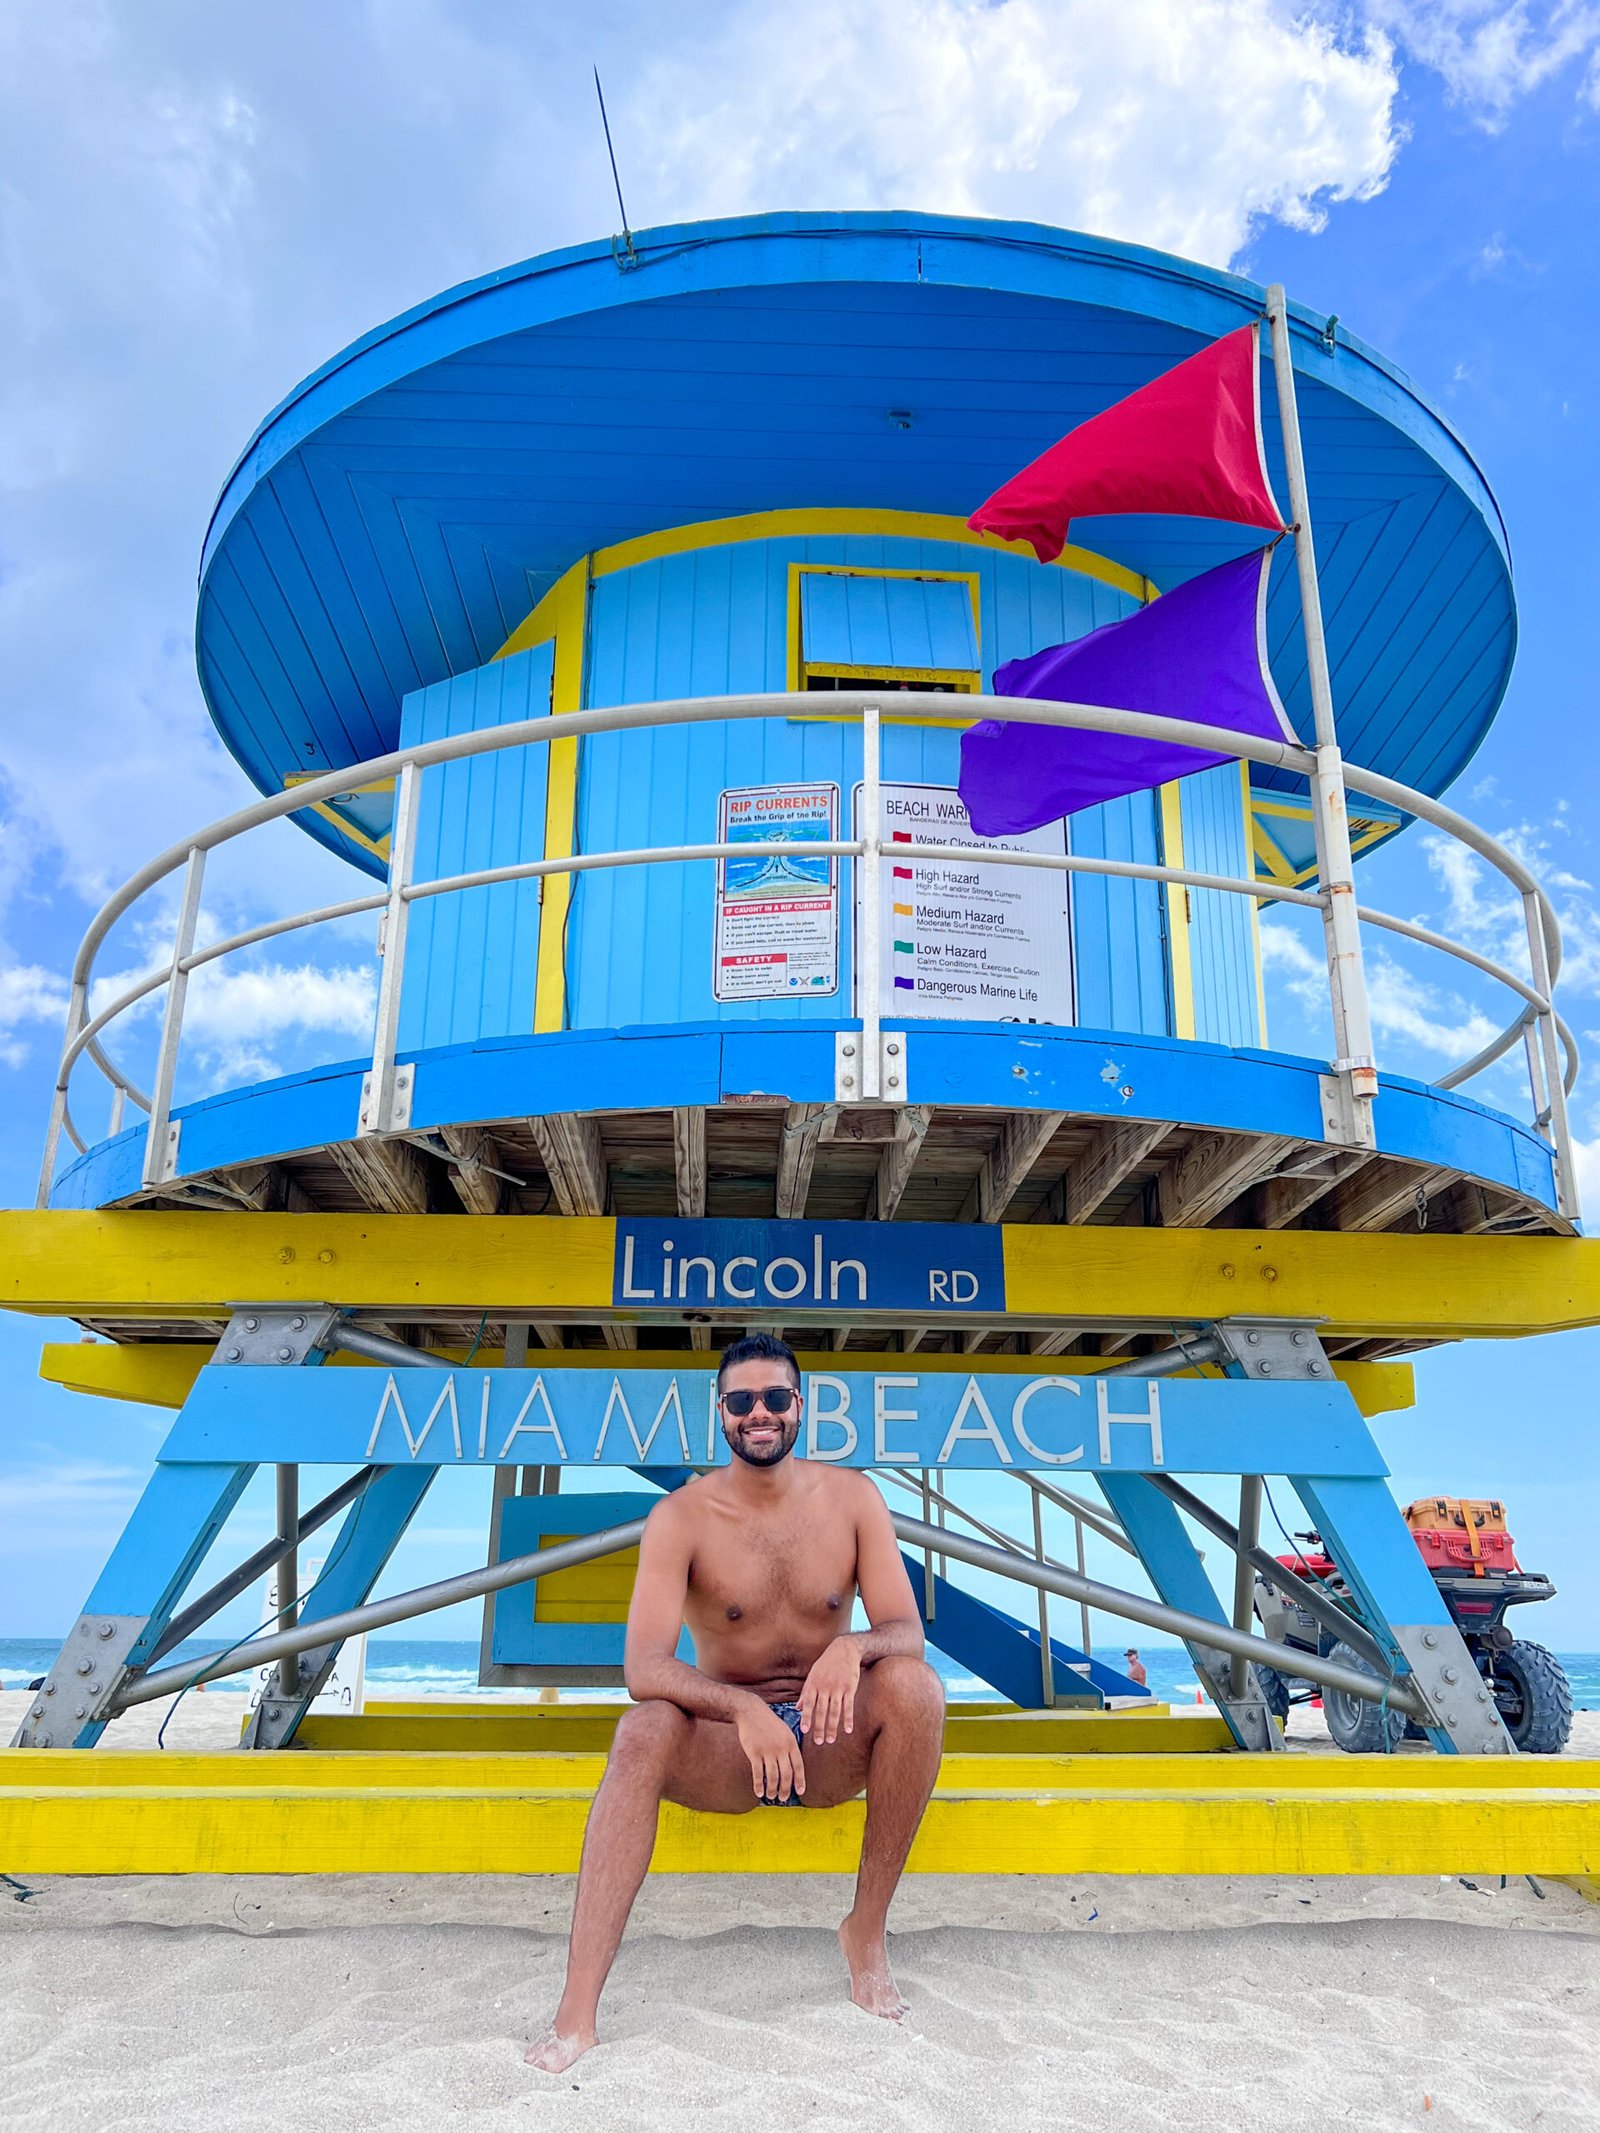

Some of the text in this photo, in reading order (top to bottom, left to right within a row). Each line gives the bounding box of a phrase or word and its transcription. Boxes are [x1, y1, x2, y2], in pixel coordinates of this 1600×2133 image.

[730, 796, 828, 812] RIP CURRENTS
[886, 800, 929, 816] BEACH
[768, 813, 784, 821] Grip
[916, 834, 947, 846] Water
[916, 869, 980, 885] High Hazard
[972, 887, 993, 897] Strong
[994, 890, 1022, 900] Currents
[916, 905, 1004, 925] Medium Hazard
[916, 918, 951, 927] Moderate
[970, 922, 993, 931] and/or
[995, 925, 1025, 935] Currents
[917, 942, 986, 959] Low Hazard
[736, 956, 772, 964] SAFETY
[981, 963, 1011, 972] Exercise
[1013, 967, 1040, 976] Caution
[918, 979, 1038, 1002] Dangerous Marine Life
[622, 1234, 979, 1302] Lincoln RD
[365, 1372, 1164, 1466] MIAMI BEACH
